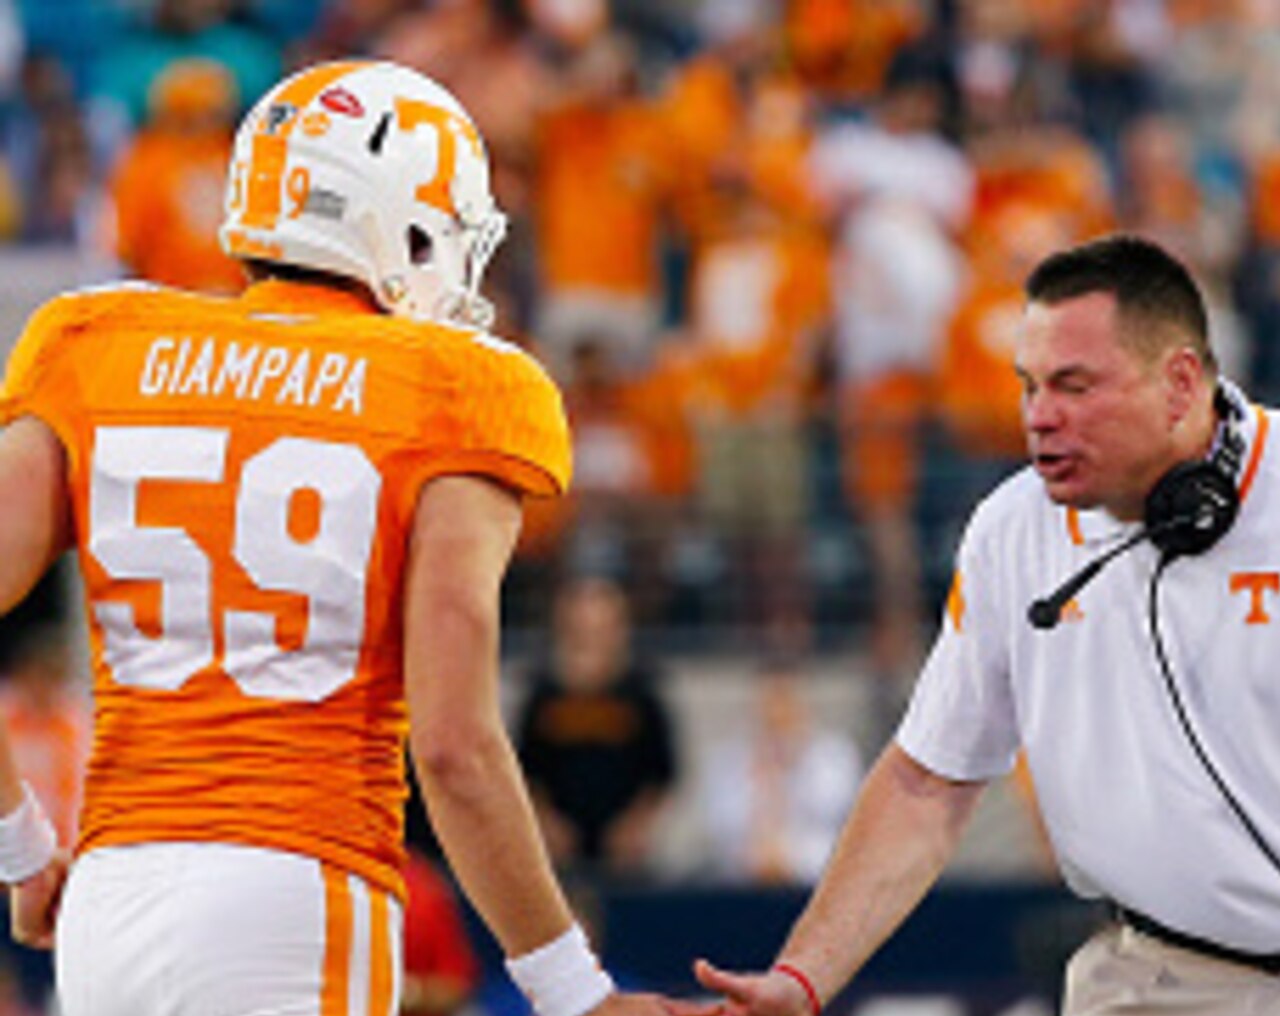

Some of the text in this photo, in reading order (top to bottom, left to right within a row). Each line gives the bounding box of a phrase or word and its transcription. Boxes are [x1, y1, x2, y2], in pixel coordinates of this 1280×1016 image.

[394, 96, 483, 218] T
[139, 337, 369, 415] GIAMPAPA
[88, 425, 383, 703] 59
[1229, 572, 1280, 624] T
